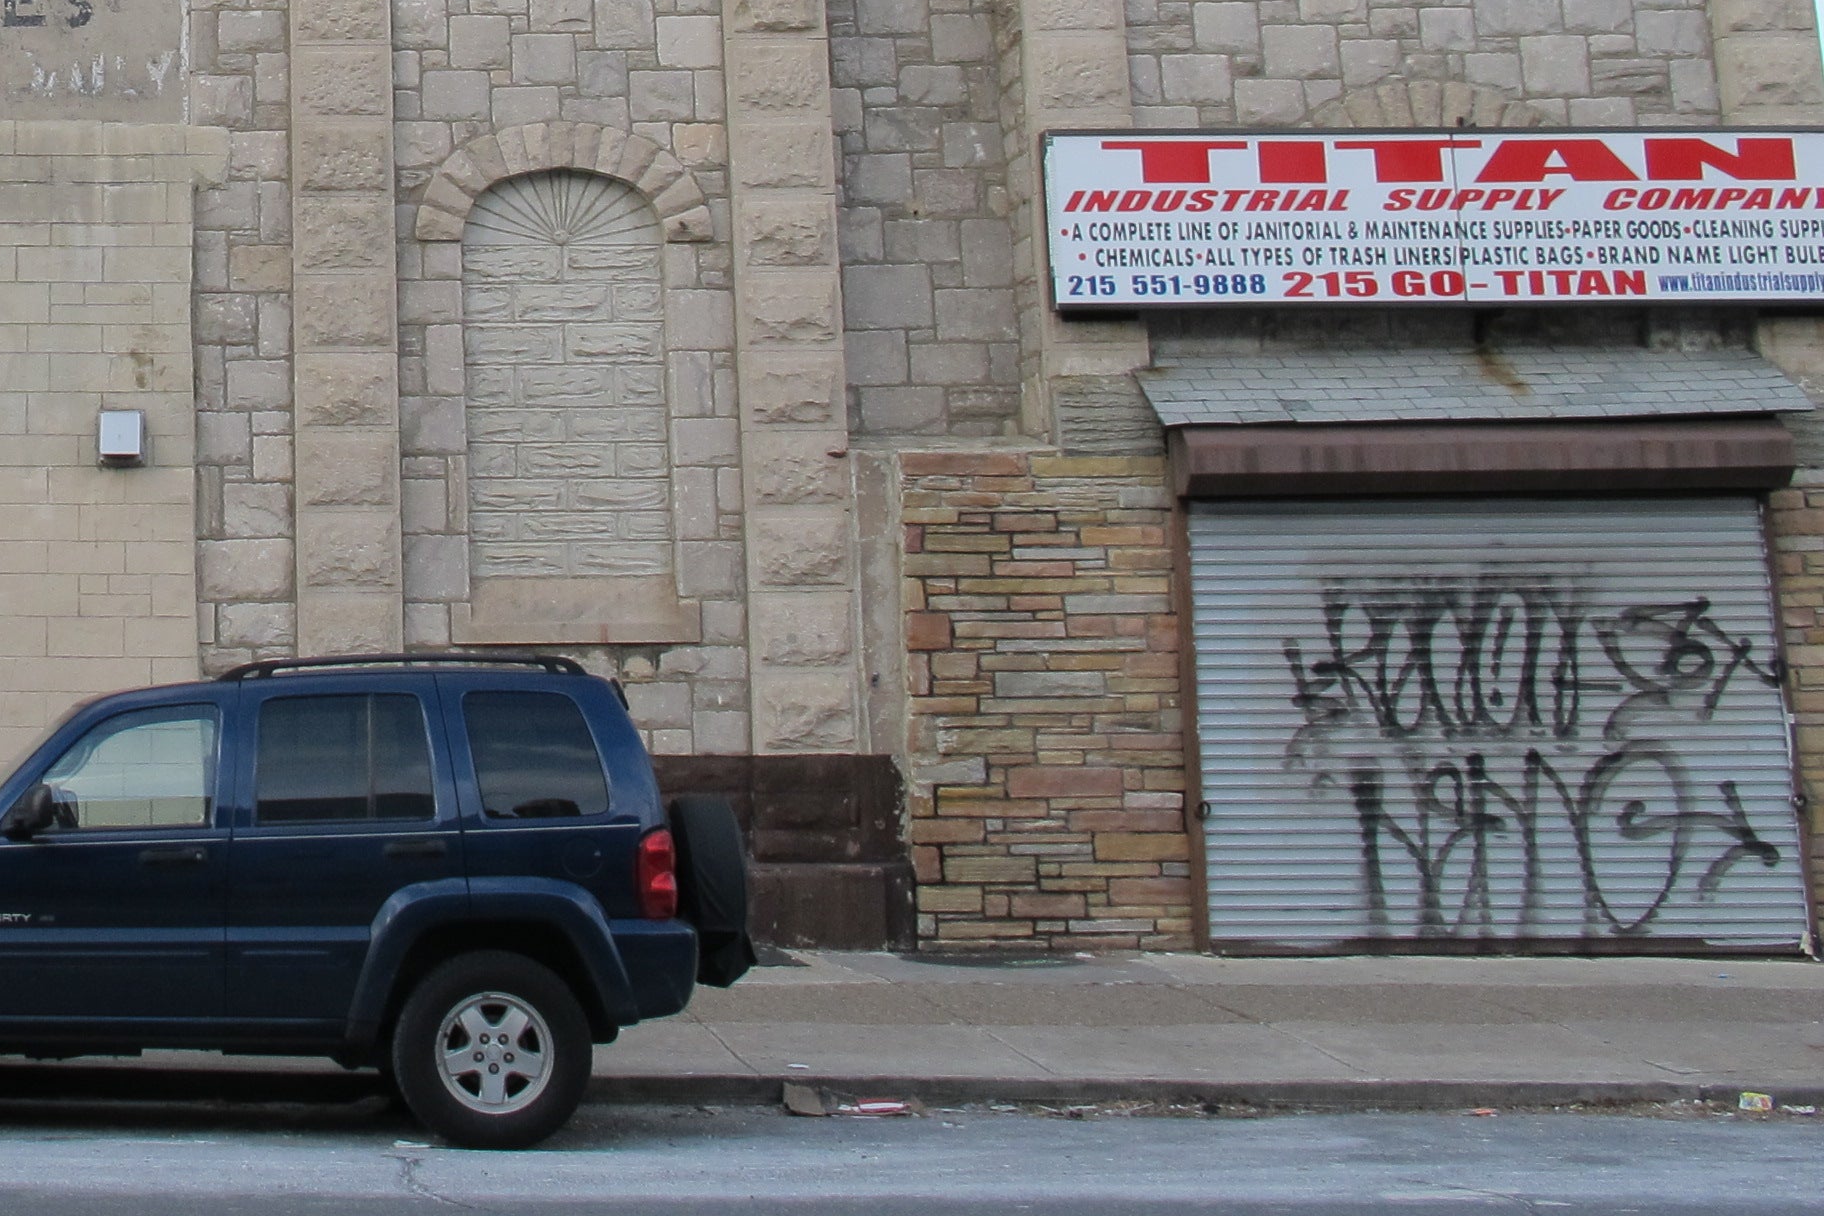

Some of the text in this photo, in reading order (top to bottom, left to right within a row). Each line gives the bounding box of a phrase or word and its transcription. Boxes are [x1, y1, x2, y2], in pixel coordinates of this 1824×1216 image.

[1101, 139, 1797, 184] TITAN
[1063, 189, 1349, 212] INDUSTRIAL
[1382, 188, 1566, 211] SUPPLY
[1072, 222, 1083, 242] A
[1089, 222, 1172, 242] COMPLETE
[1178, 222, 1212, 241] LINE
[1218, 221, 1239, 241] OF
[1246, 221, 1342, 241] JANITORIAL
[1347, 221, 1359, 240] &
[1366, 220, 1487, 240] MAINTENANCE
[1572, 220, 1622, 239] PAPER
[1626, 220, 1682, 240] GOODS
[1693, 219, 1774, 239] CLEANING
[1095, 247, 1195, 268] CHEMICALS
[1205, 247, 1236, 266] ALL
[1241, 247, 1294, 266] TYPES
[1302, 246, 1323, 266] OF
[1329, 246, 1387, 266] TRASH
[1536, 246, 1584, 265] BAGS
[1598, 245, 1661, 265] BRAND
[1667, 245, 1723, 264] NAME
[1729, 245, 1778, 265] LIGHT
[1068, 273, 1267, 297] 215 551-9888
[1282, 271, 1378, 297] 215
